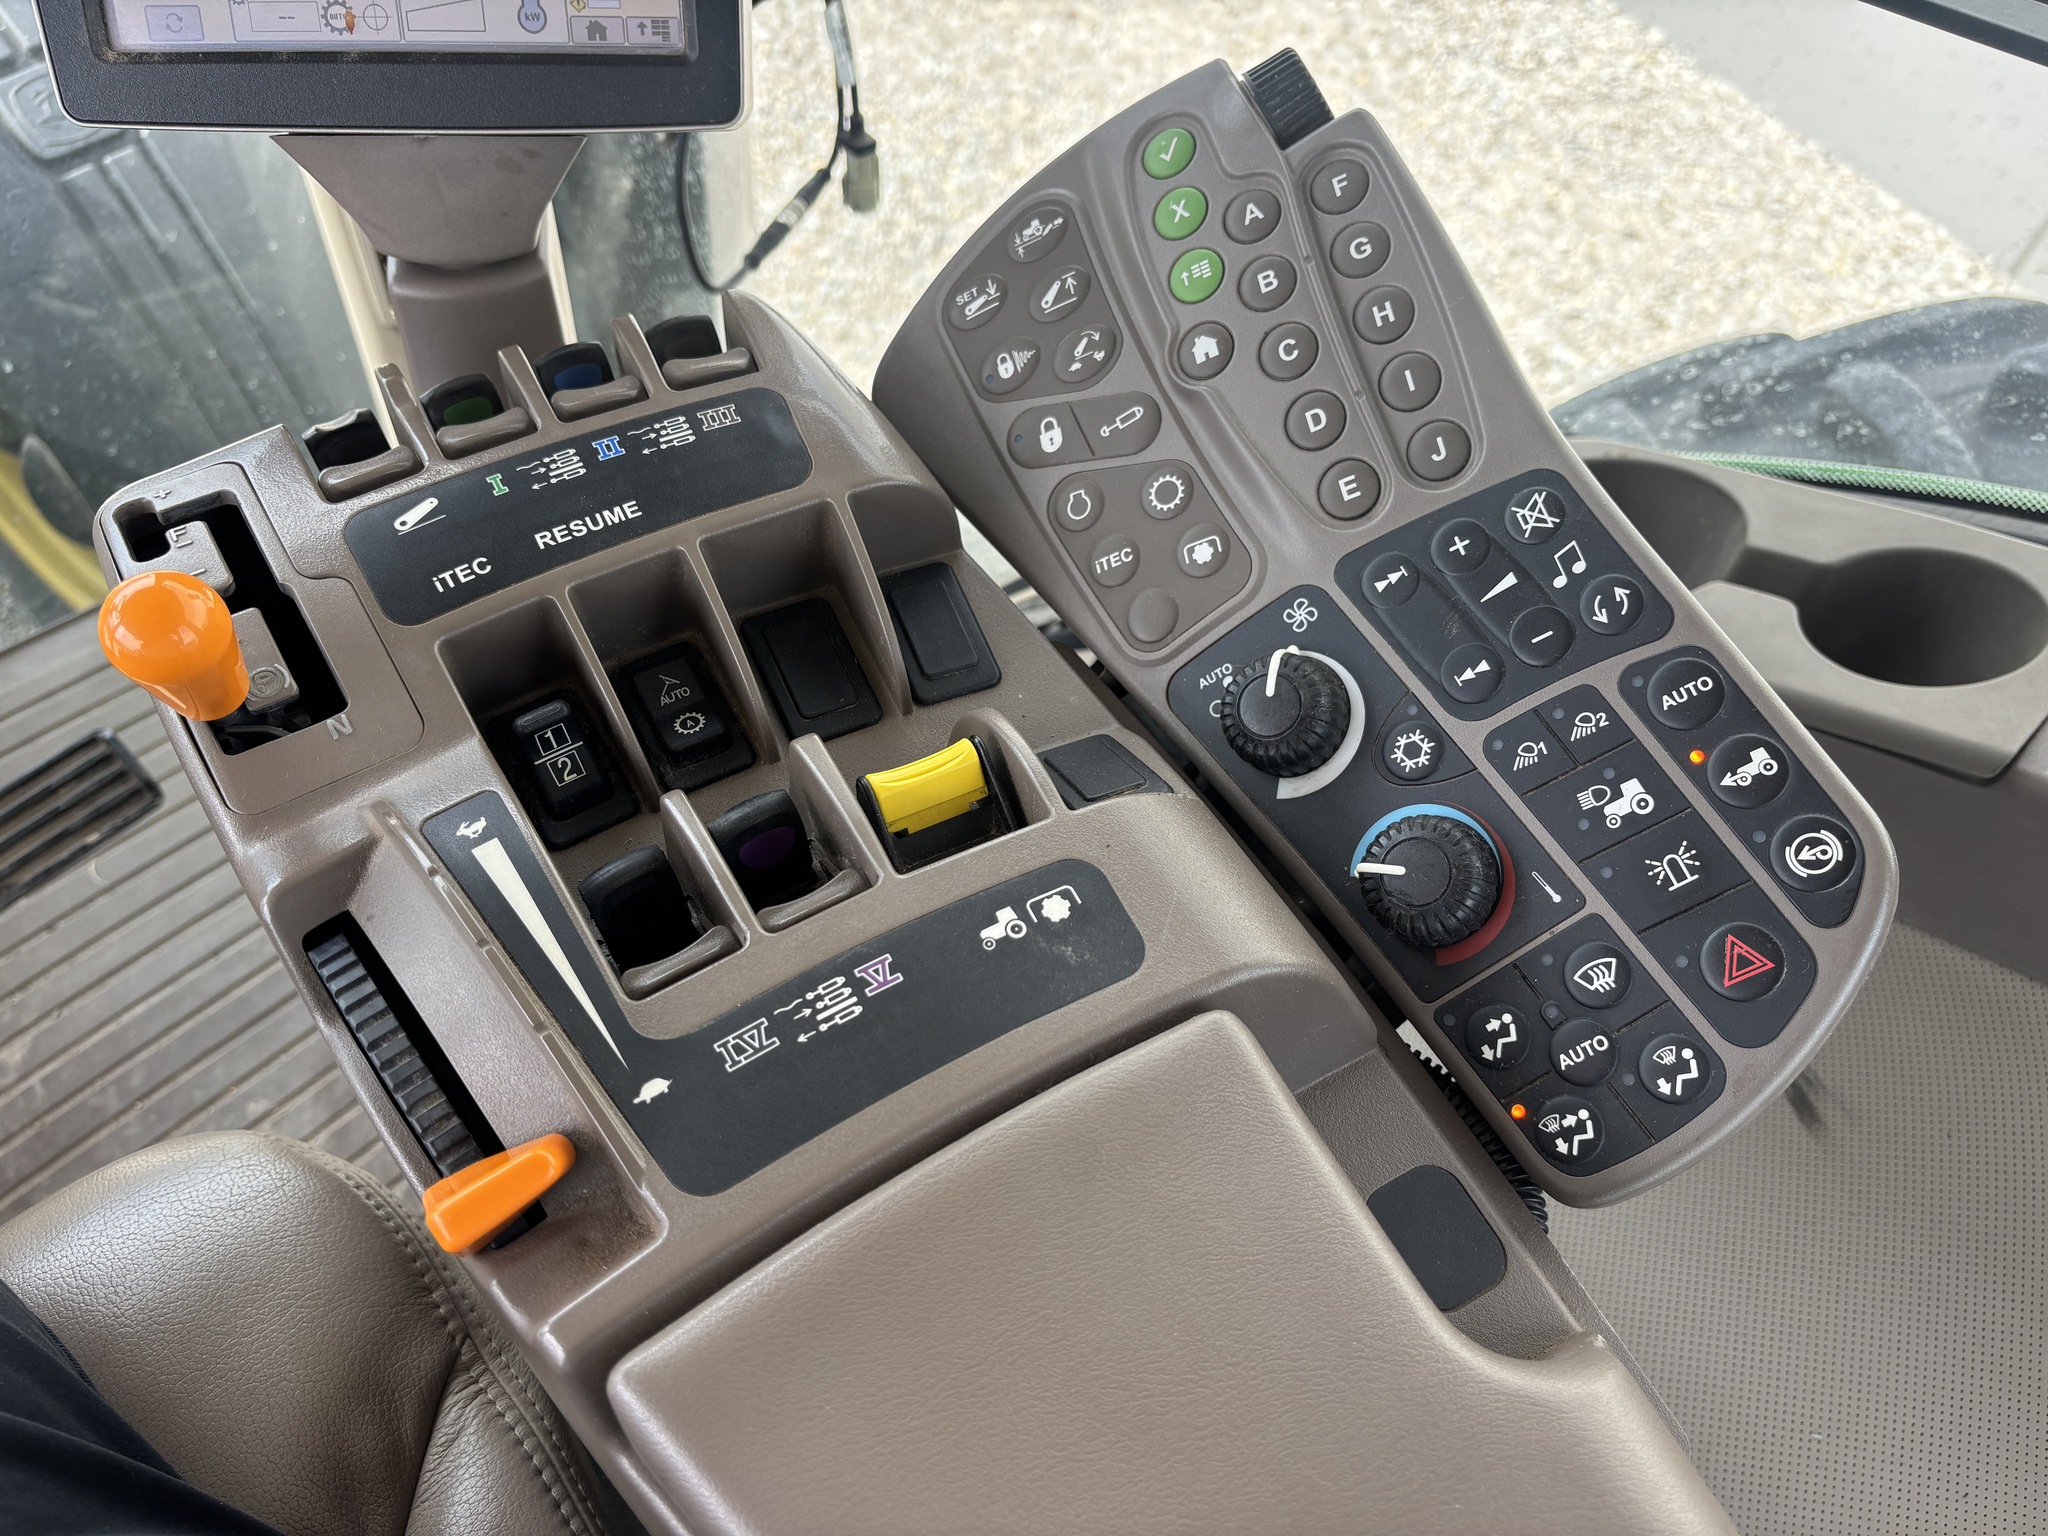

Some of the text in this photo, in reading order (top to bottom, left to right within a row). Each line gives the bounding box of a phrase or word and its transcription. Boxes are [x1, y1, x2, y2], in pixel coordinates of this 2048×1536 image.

[524, 12, 540, 21] kW
[1332, 174, 1347, 197] F
[1245, 203, 1264, 225] A
[1349, 237, 1373, 260] G
[1257, 270, 1278, 293] B
[956, 287, 978, 306] SET
[1372, 301, 1395, 327] H
[1279, 339, 1298, 361] C
[1405, 370, 1415, 391] I
[697, 404, 741, 431] III
[1305, 409, 1326, 432] D
[592, 436, 626, 461] II
[1431, 437, 1446, 461] J
[486, 474, 509, 496] I
[1338, 475, 1361, 501] E
[535, 501, 642, 549] RESUME
[1095, 548, 1133, 573] iTEC
[433, 557, 492, 593] iTEC
[1199, 663, 1233, 690] AUTO
[661, 684, 690, 706] AUTO
[1663, 677, 1713, 710] AUTO
[326, 713, 353, 740] N
[687, 719, 696, 729] A
[1596, 712, 1610, 728] 2
[544, 730, 559, 750] 1
[1537, 741, 1548, 755] 1
[557, 757, 578, 782] 2
[854, 954, 903, 997] V
[713, 1018, 780, 1072] IV
[1560, 1036, 1608, 1070] AUTO
